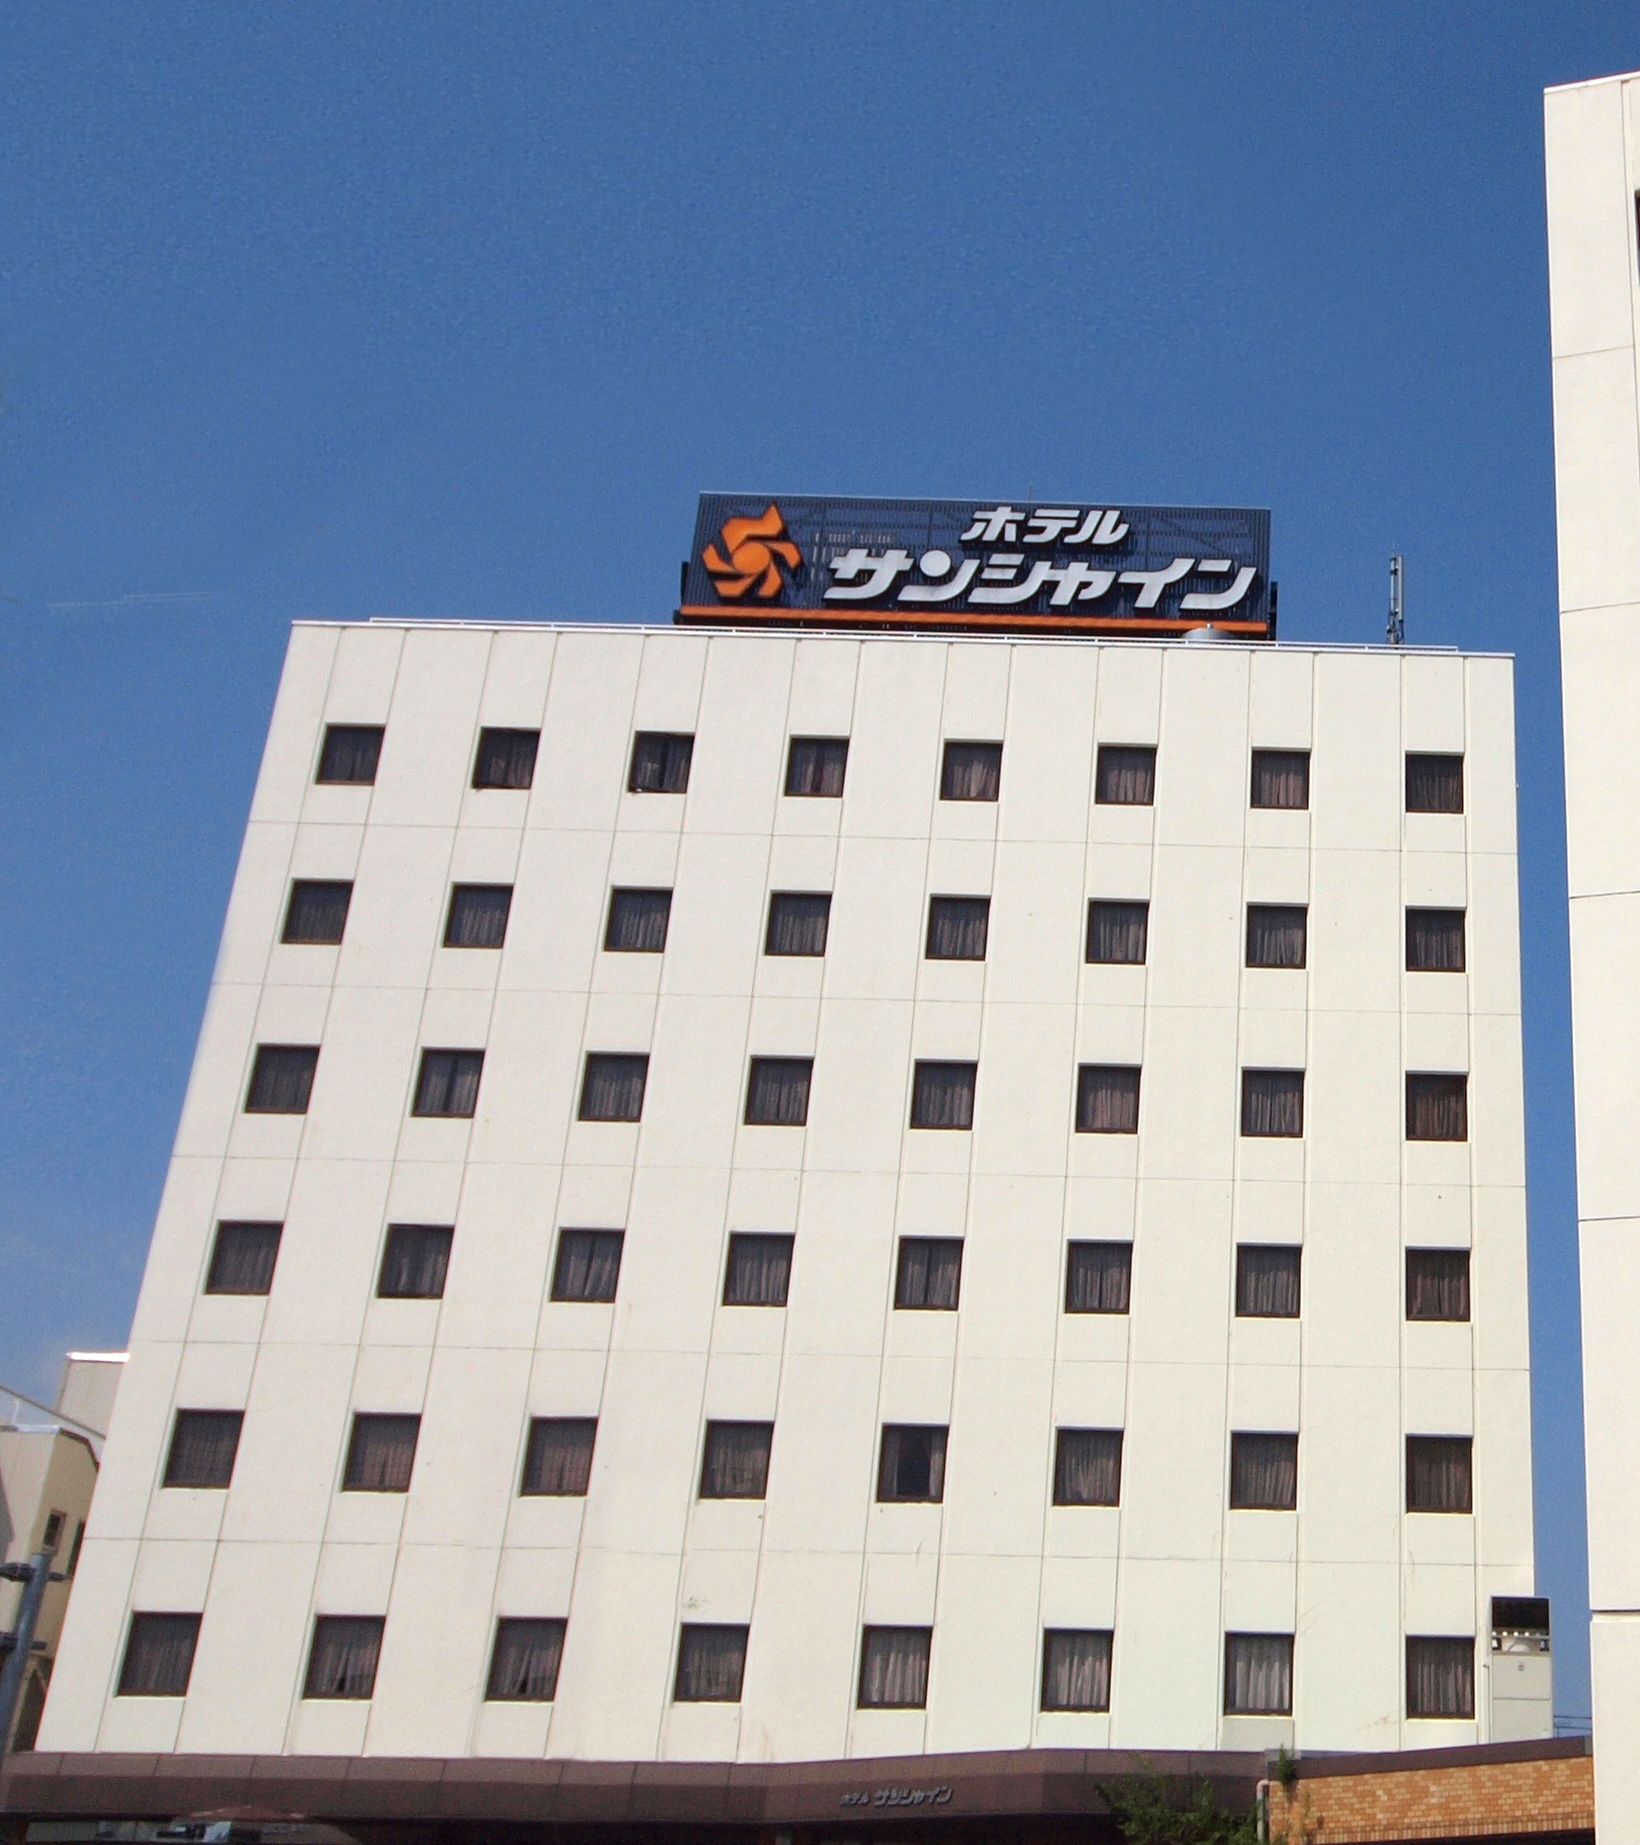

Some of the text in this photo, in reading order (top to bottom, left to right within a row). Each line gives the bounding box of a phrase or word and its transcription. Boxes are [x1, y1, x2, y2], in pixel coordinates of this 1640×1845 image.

[960, 506, 1130, 545] ホテル
[823, 548, 1257, 611] サンシャイン
[839, 1791, 870, 1806] ホテル
